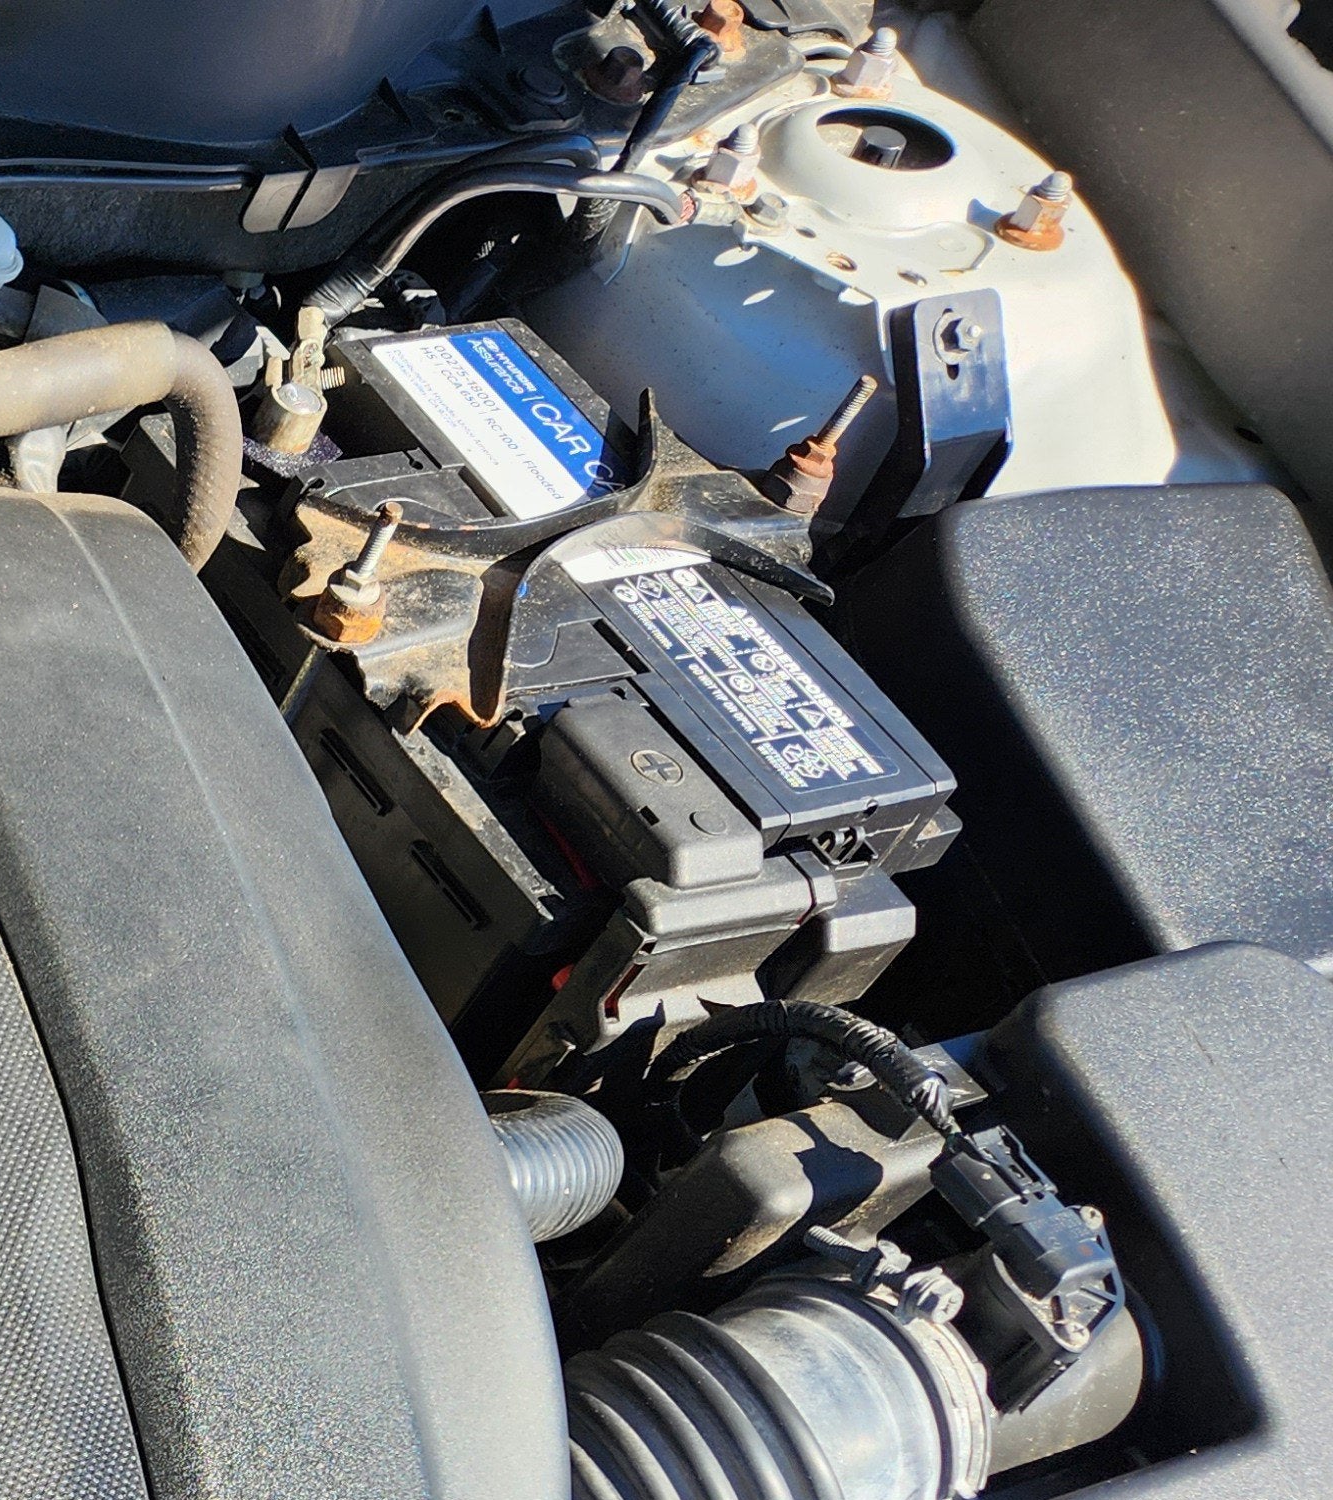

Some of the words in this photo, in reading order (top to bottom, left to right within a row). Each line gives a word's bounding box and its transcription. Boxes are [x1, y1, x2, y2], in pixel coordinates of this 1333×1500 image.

[457, 390, 481, 408] 650
[521, 460, 565, 499] Flooded
[465, 339, 527, 394] Assurance
[525, 401, 595, 455] CAR
[740, 617, 855, 728] DANGER/POISON
